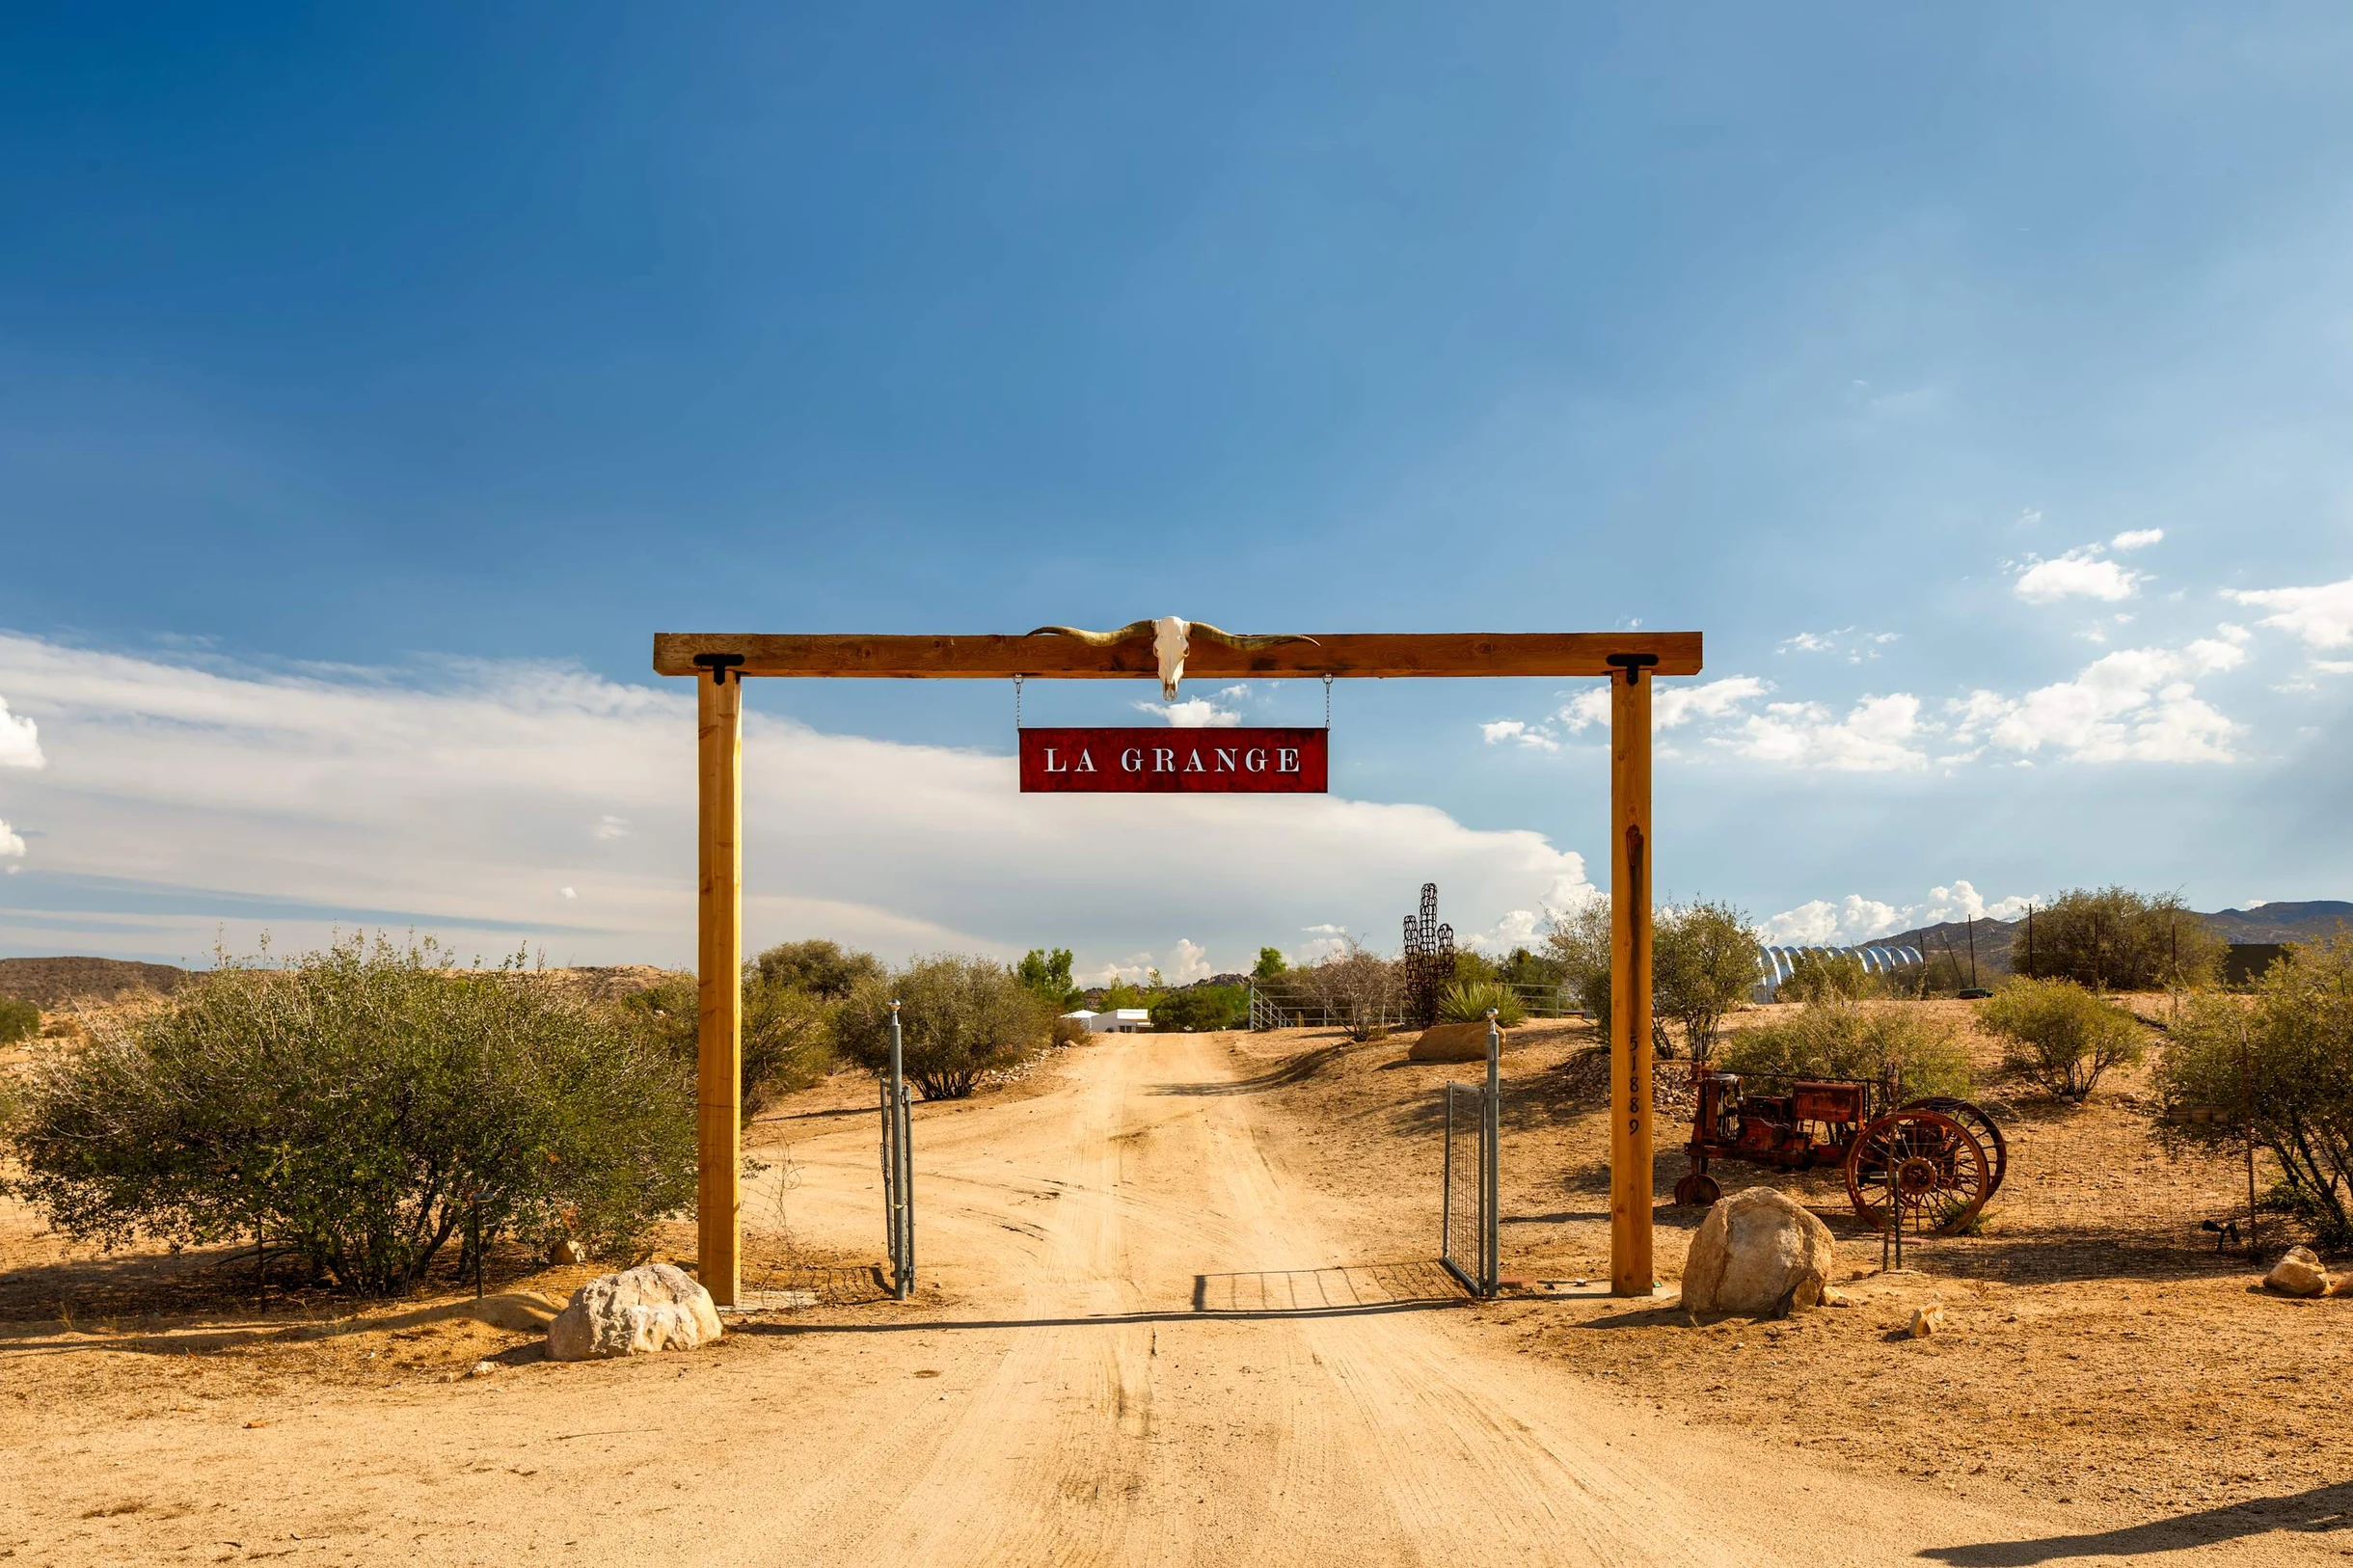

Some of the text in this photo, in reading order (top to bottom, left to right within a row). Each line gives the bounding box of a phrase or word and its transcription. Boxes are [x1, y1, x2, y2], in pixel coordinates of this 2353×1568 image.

[1043, 747, 1299, 772] LA GRANGE
[1629, 1036, 1639, 1136] 51889
